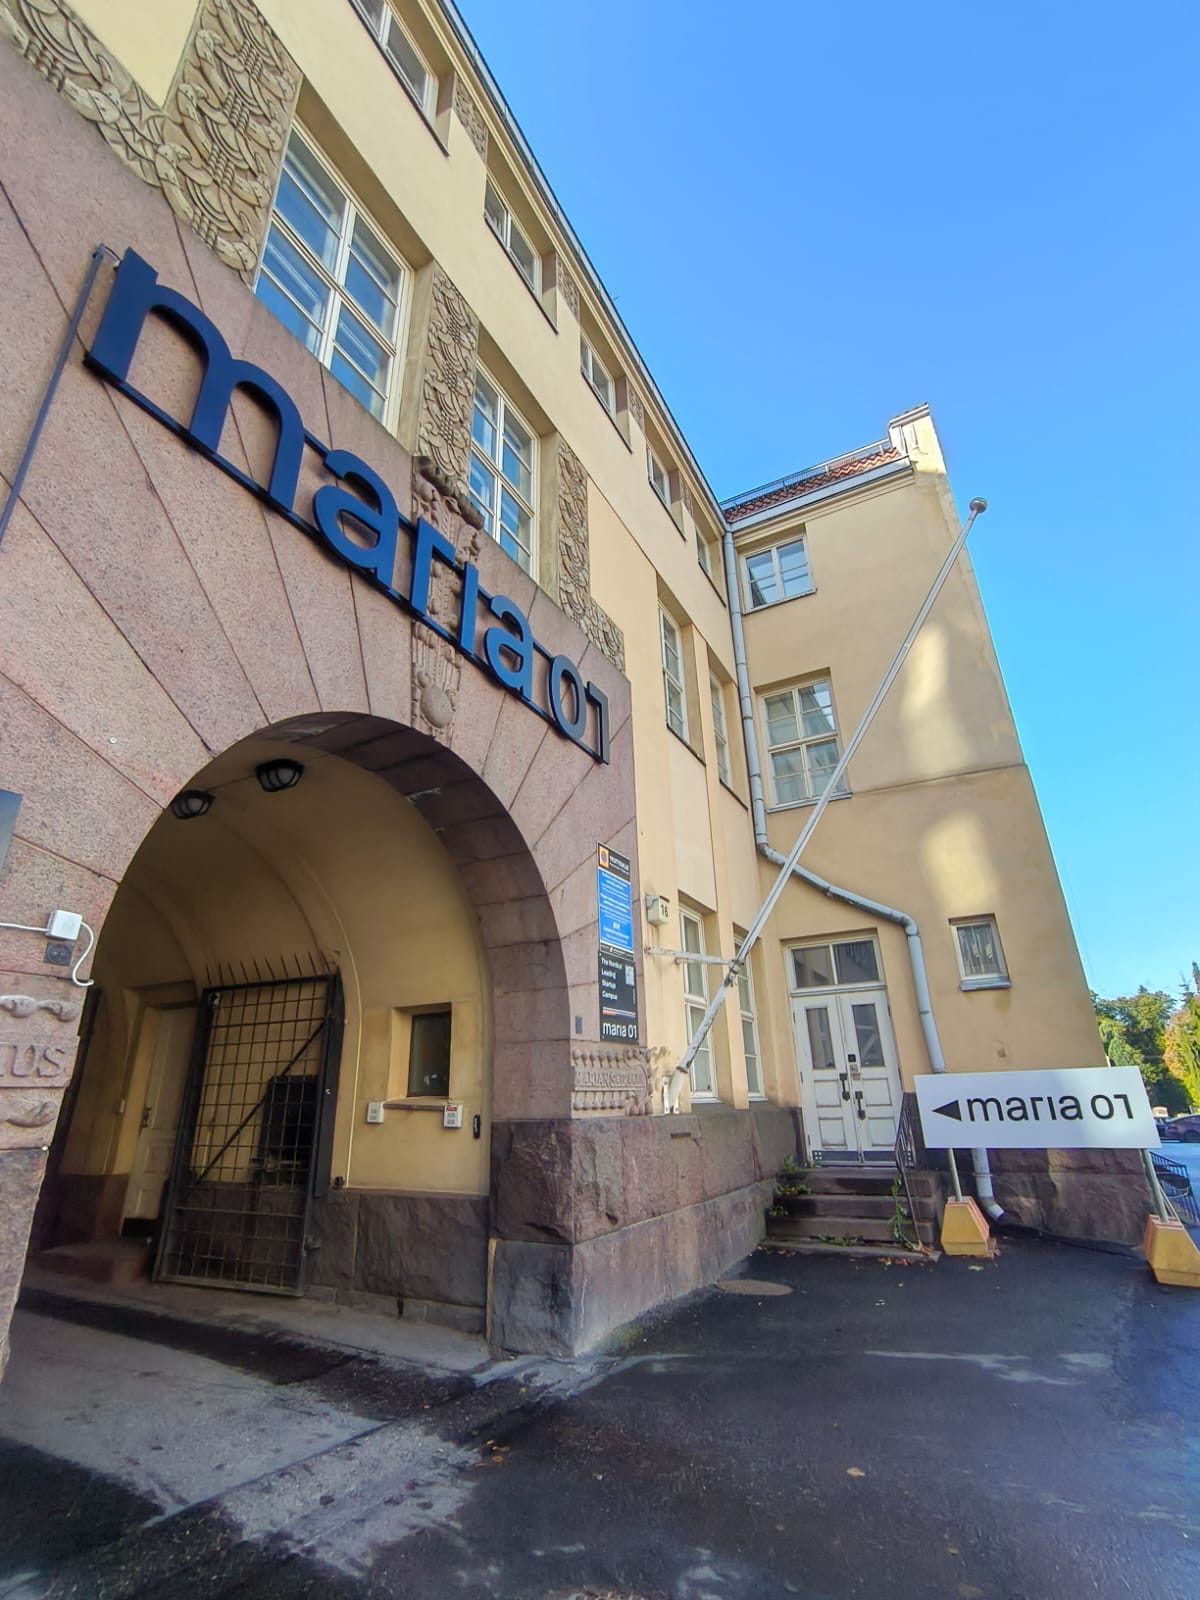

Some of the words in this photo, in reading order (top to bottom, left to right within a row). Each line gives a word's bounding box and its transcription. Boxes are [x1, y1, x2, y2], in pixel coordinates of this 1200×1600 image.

[86, 247, 533, 702] maria
[0, 1044, 66, 1079] US
[966, 1096, 1083, 1122] maria
